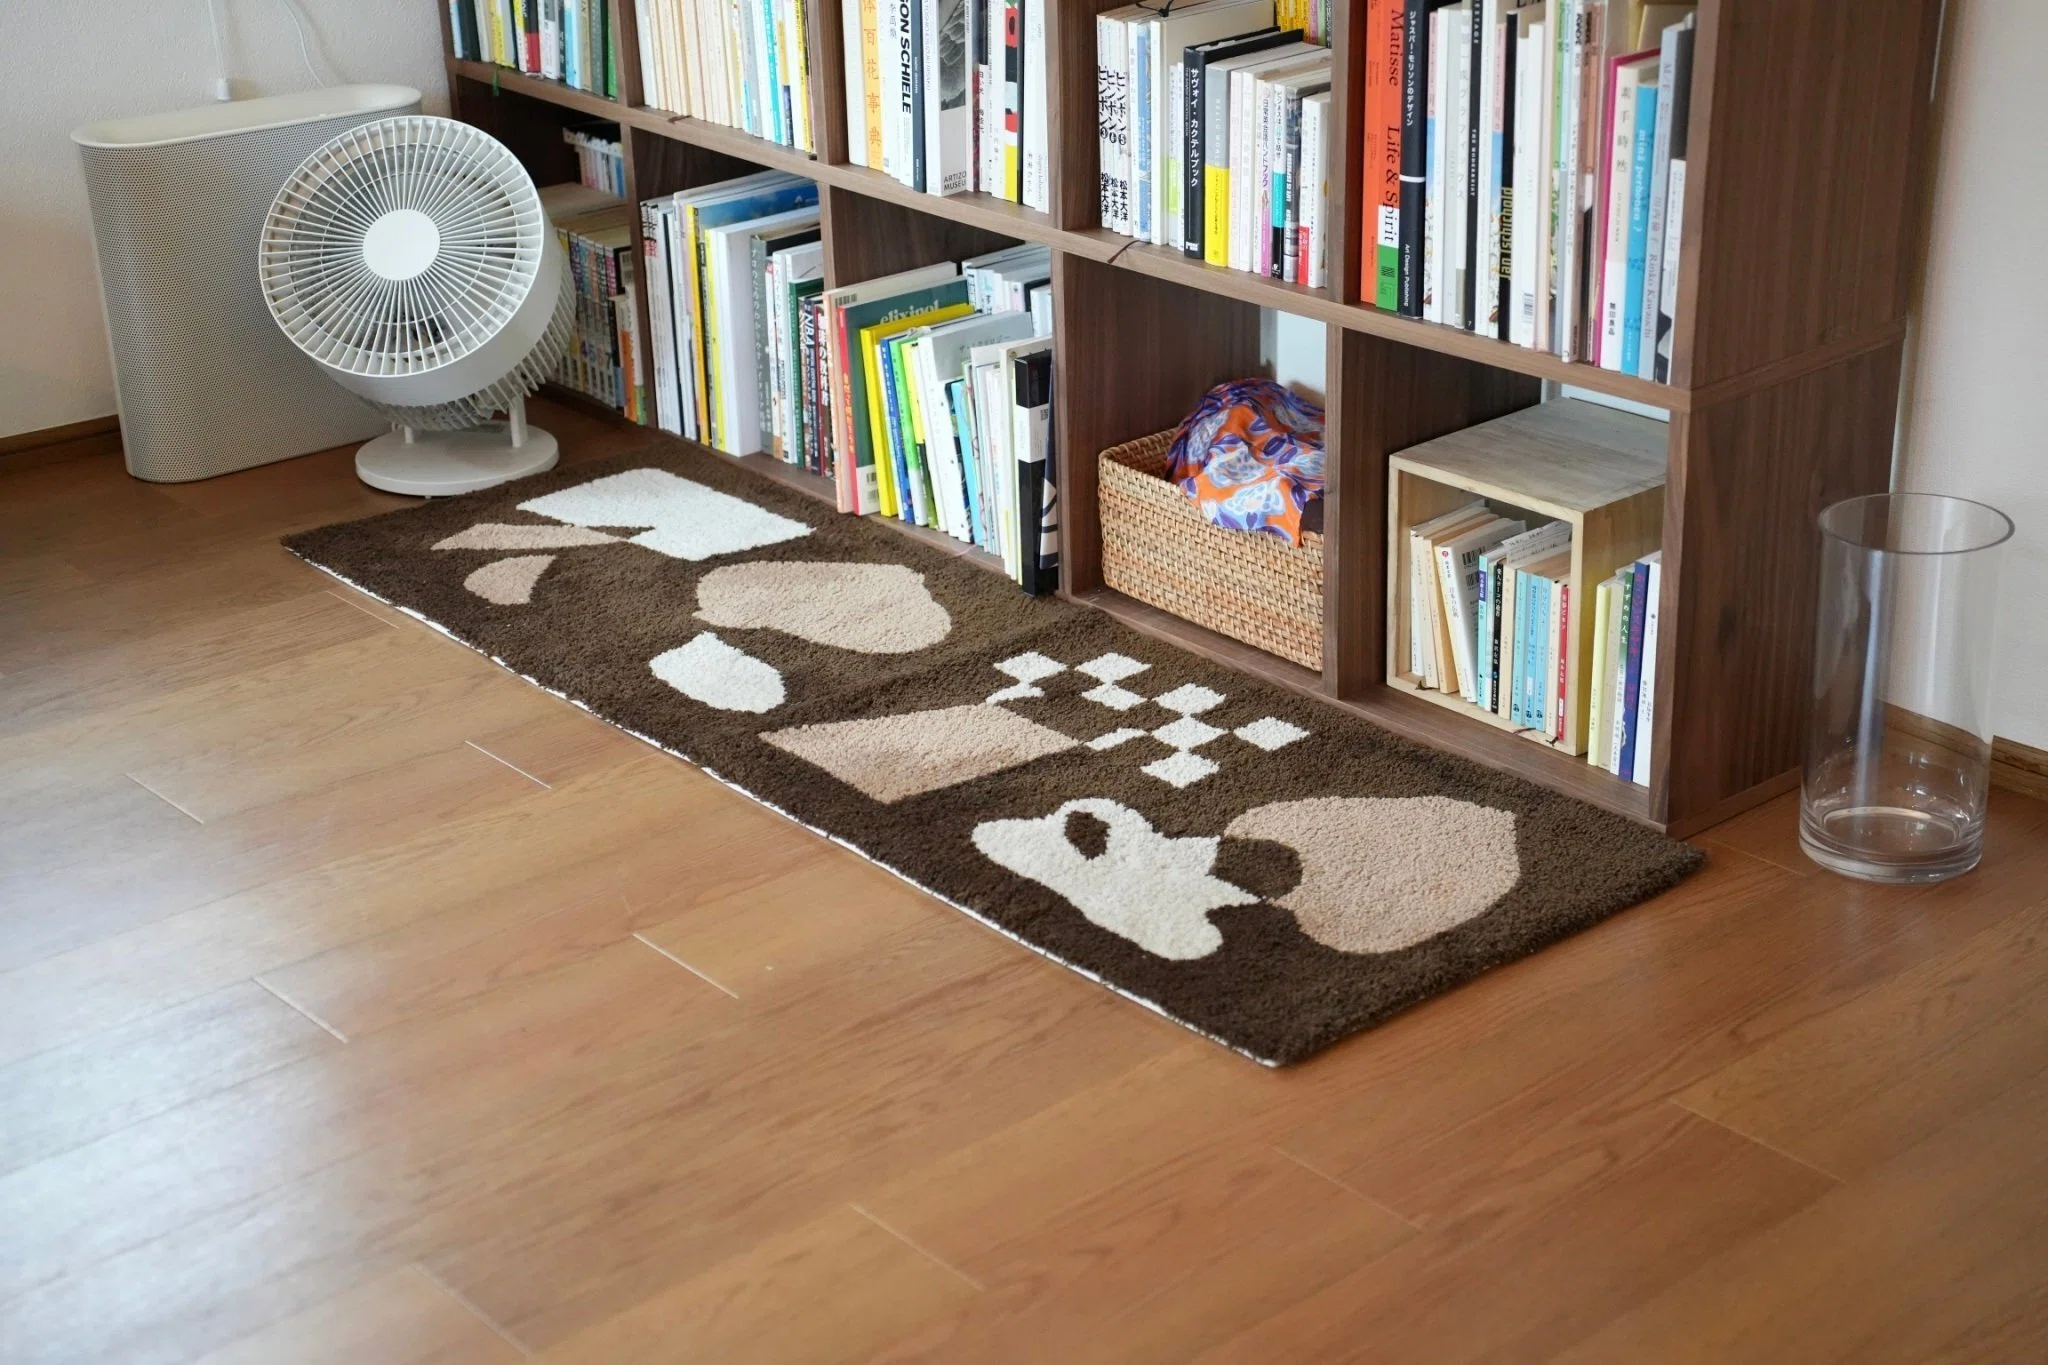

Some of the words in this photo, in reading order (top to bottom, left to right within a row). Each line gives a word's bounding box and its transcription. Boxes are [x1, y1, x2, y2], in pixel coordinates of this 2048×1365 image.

[1389, 9, 1405, 87] Matisse
[1406, 10, 1417, 127] ジャスパー・モリソンのデザイン
[900, 36, 912, 115] SCHIELE
[1190, 67, 1200, 188] サヴォイ・カクテルブック
[1386, 126, 1401, 166] Life
[1100, 172, 1110, 217] 松本大洋
[1110, 177, 1120, 220] 松本大洋
[1384, 168, 1398, 187] &
[1633, 165, 1645, 221] perhonen
[1119, 180, 1129, 222] 松本大洋
[1379, 190, 1398, 243] Spirit
[1499, 257, 1511, 280] Jan
[1648, 254, 1657, 286] Rinko
[1403, 276, 1411, 307] Publishing
[1644, 289, 1656, 338] Kawauchi
[803, 312, 816, 346] NBA
